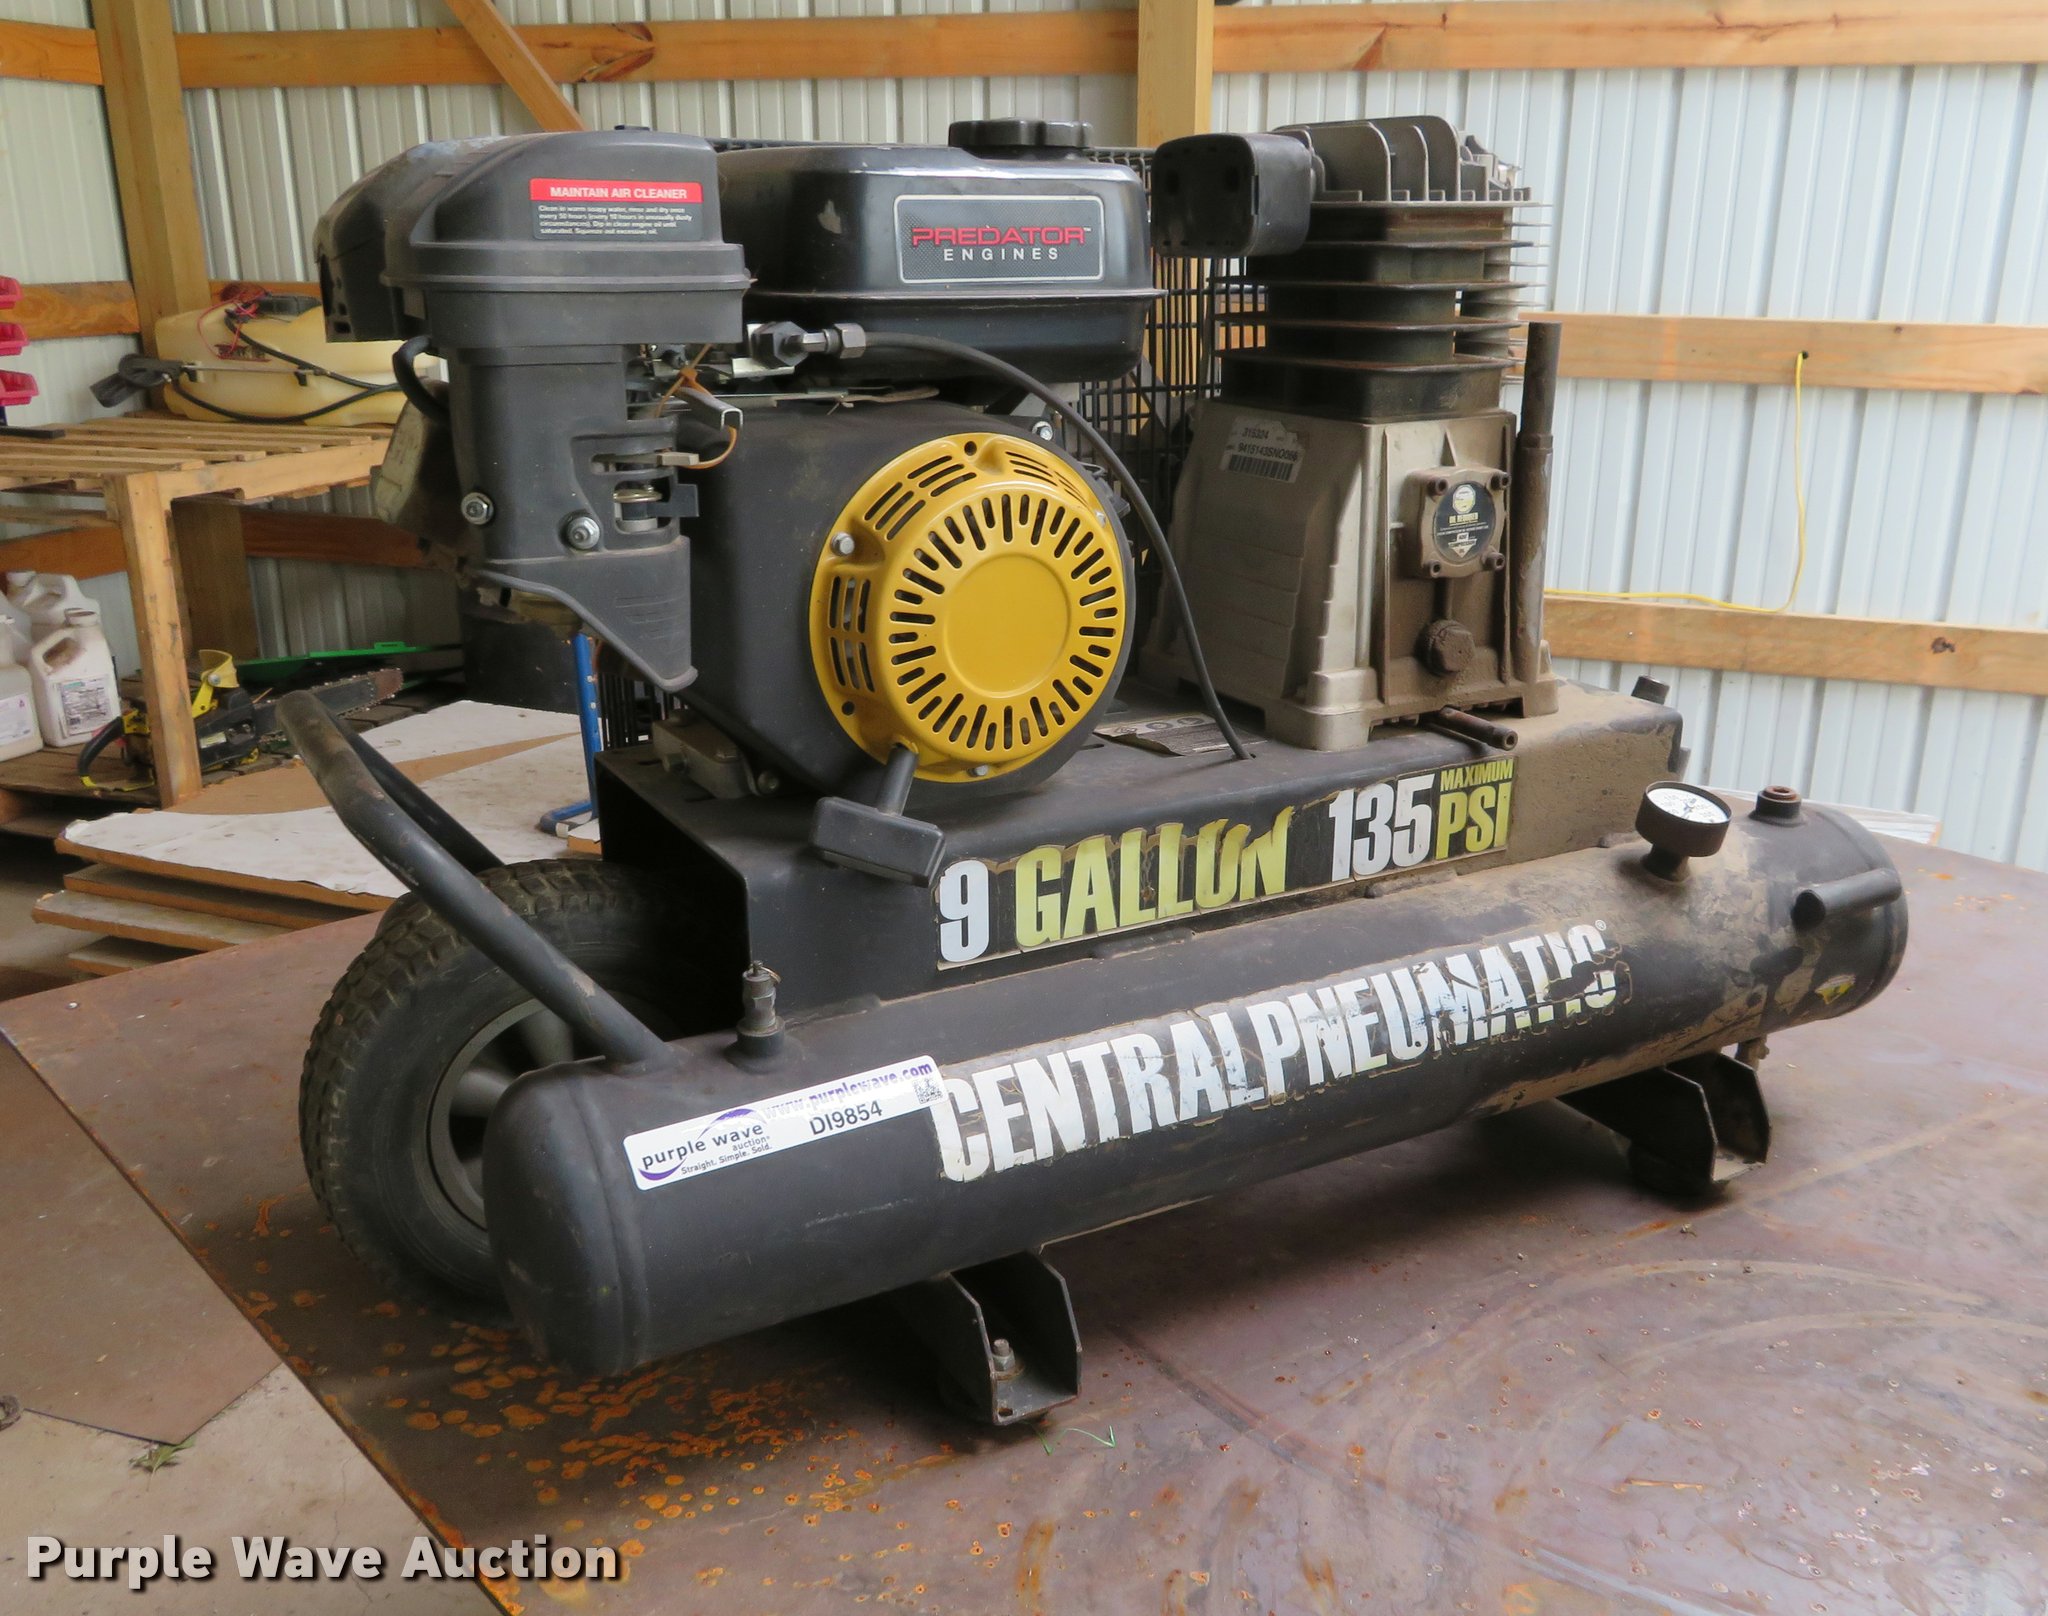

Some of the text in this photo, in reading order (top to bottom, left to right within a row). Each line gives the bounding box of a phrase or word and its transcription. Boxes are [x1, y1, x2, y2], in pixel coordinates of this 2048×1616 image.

[550, 187, 688, 199] MAINTAIN AIR CLEANER
[912, 227, 1085, 247] PREDATOR
[944, 248, 1058, 261] ENGINES
[1440, 759, 1514, 791] MAXIMUM
[940, 774, 1512, 962] 9 GALLON 135 PSI
[810, 1100, 883, 1135] DI9854
[641, 1124, 764, 1170] purple wave
[681, 1143, 773, 1175] Straight. Simple. Sold.
[732, 1137, 767, 1152] auction
